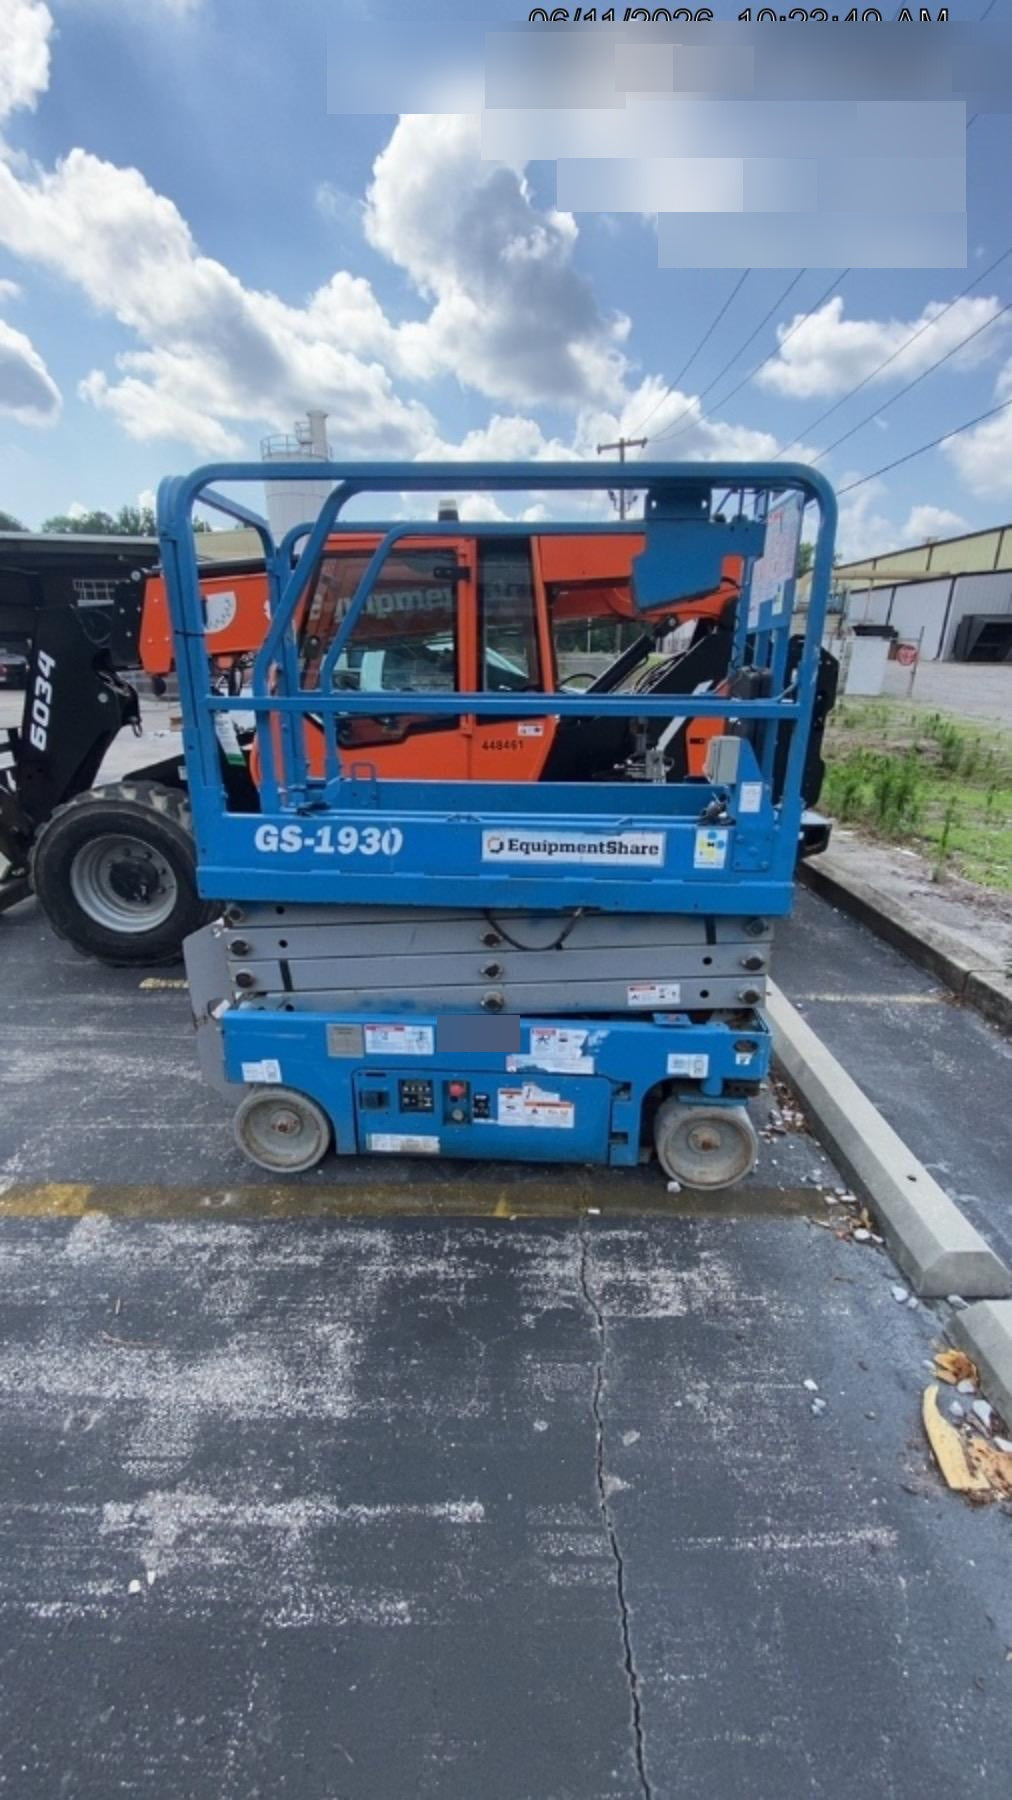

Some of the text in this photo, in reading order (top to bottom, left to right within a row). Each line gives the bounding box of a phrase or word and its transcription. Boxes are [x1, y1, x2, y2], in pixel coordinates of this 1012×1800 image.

[30, 650, 56, 752] 6034
[254, 824, 404, 856] GS-1930
[507, 838, 660, 856] EquipmentShare
